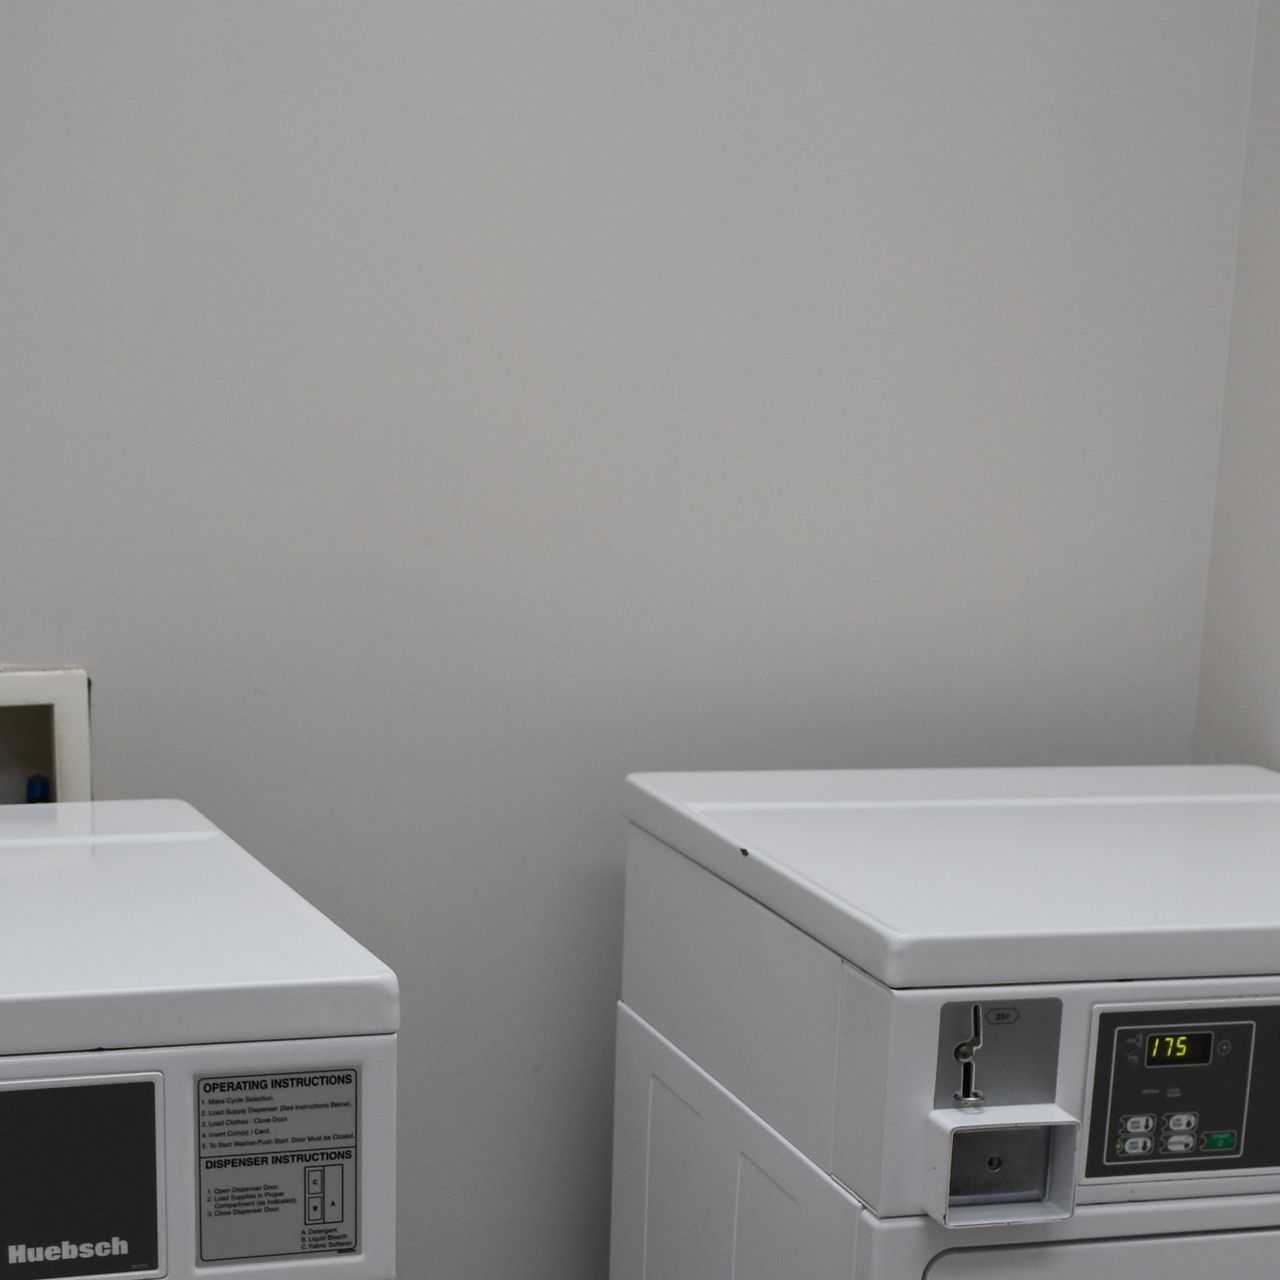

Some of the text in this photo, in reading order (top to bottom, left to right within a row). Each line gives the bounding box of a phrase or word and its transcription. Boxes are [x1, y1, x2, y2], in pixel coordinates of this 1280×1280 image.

[1152, 1036, 1187, 1057] 175
[203, 1074, 352, 1093] OPERATING INSTRUCTIONS
[226, 1096, 244, 1105] Cycle
[248, 1106, 278, 1114] Dispenser
[205, 1150, 352, 1169] DISPENSER INSTRUCTIONS
[8, 1236, 129, 1264] Huebsch
